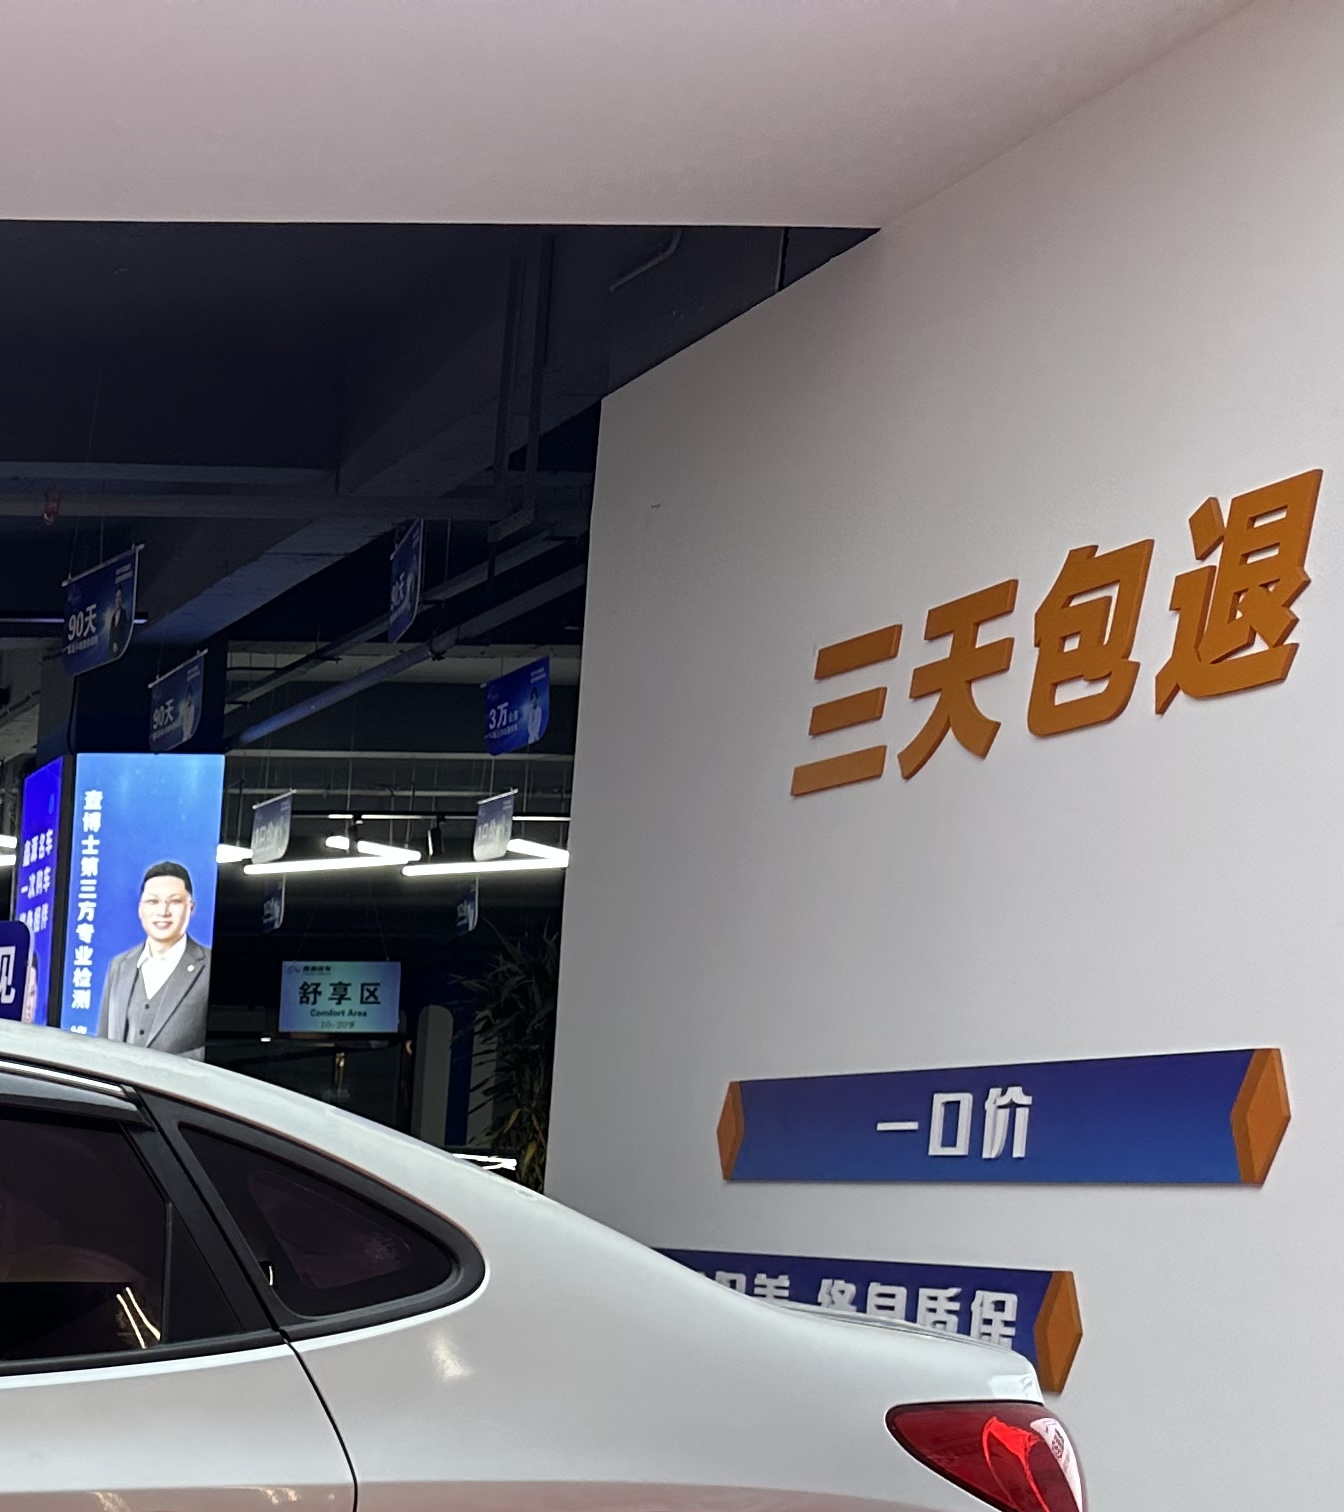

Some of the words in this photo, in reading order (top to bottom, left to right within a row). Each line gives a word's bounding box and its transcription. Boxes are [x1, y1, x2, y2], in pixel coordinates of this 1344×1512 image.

[67, 603, 97, 641] 90天
[789, 467, 1324, 797] 三天包退
[71, 790, 103, 1010] 查博士第三方专业检测
[298, 981, 381, 1006] 舒享区
[310, 1009, 345, 1017] Comfort
[347, 1009, 368, 1017] Area
[875, 1086, 1033, 1160] 一口价
